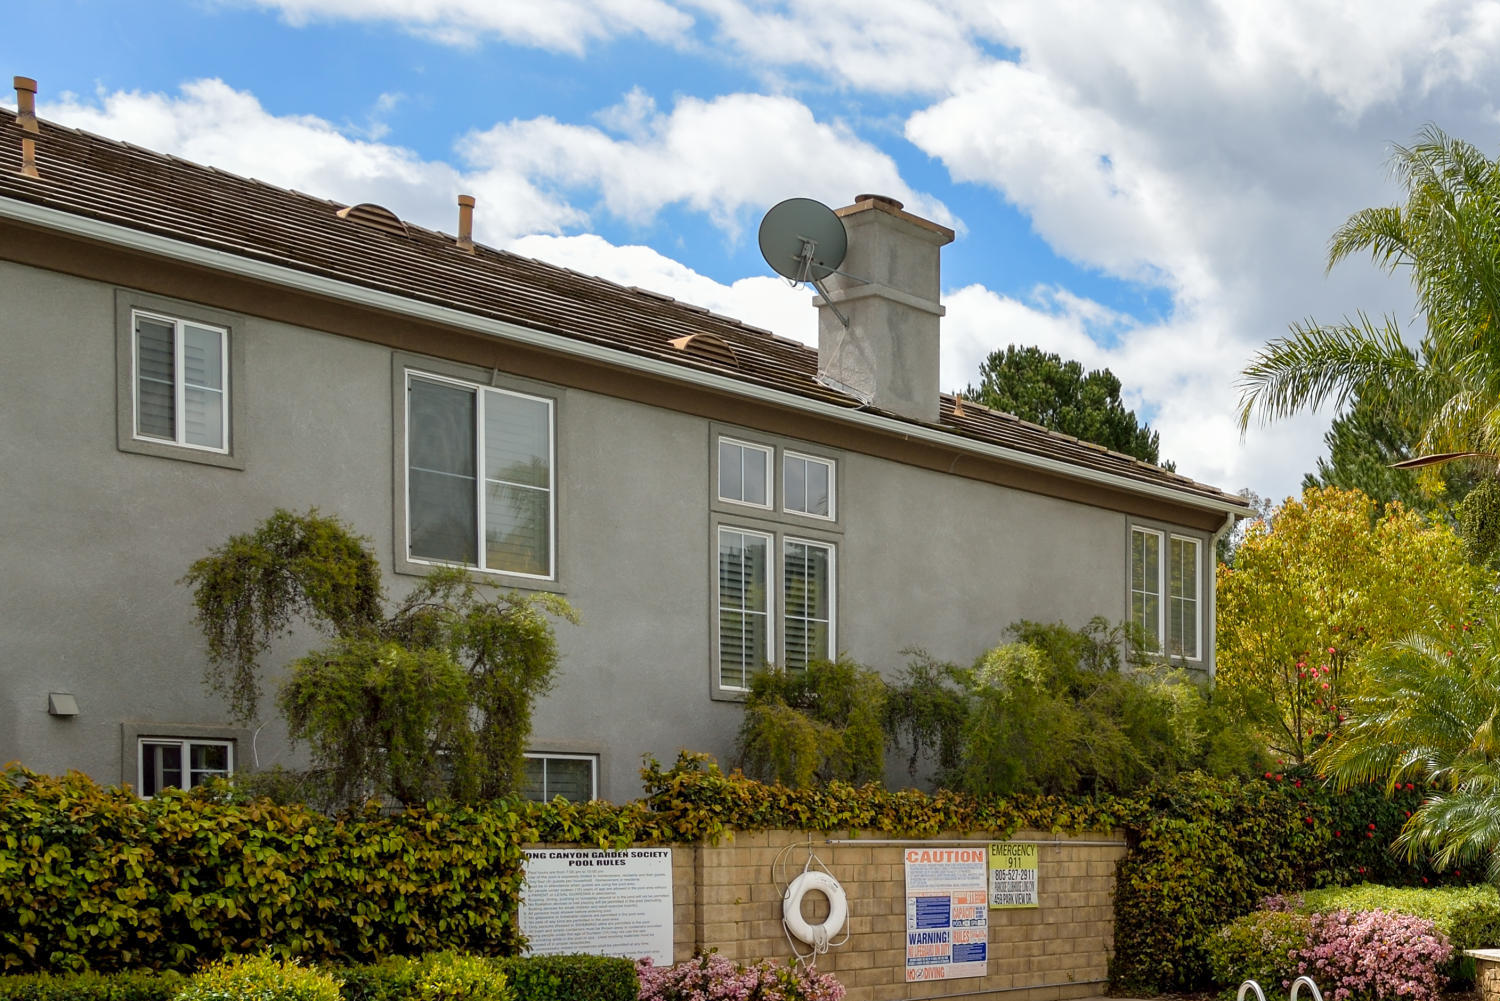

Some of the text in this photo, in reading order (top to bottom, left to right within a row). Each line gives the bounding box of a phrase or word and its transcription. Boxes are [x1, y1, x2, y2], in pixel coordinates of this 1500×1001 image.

[991, 844, 1035, 856] EMERGENCY
[907, 851, 984, 863] CAUTION
[1008, 857, 1021, 868] 911
[995, 869, 1034, 881] 805-527-2911
[908, 931, 950, 945] WARNING!
[907, 968, 915, 981] NO
[924, 966, 944, 979] DIVING
